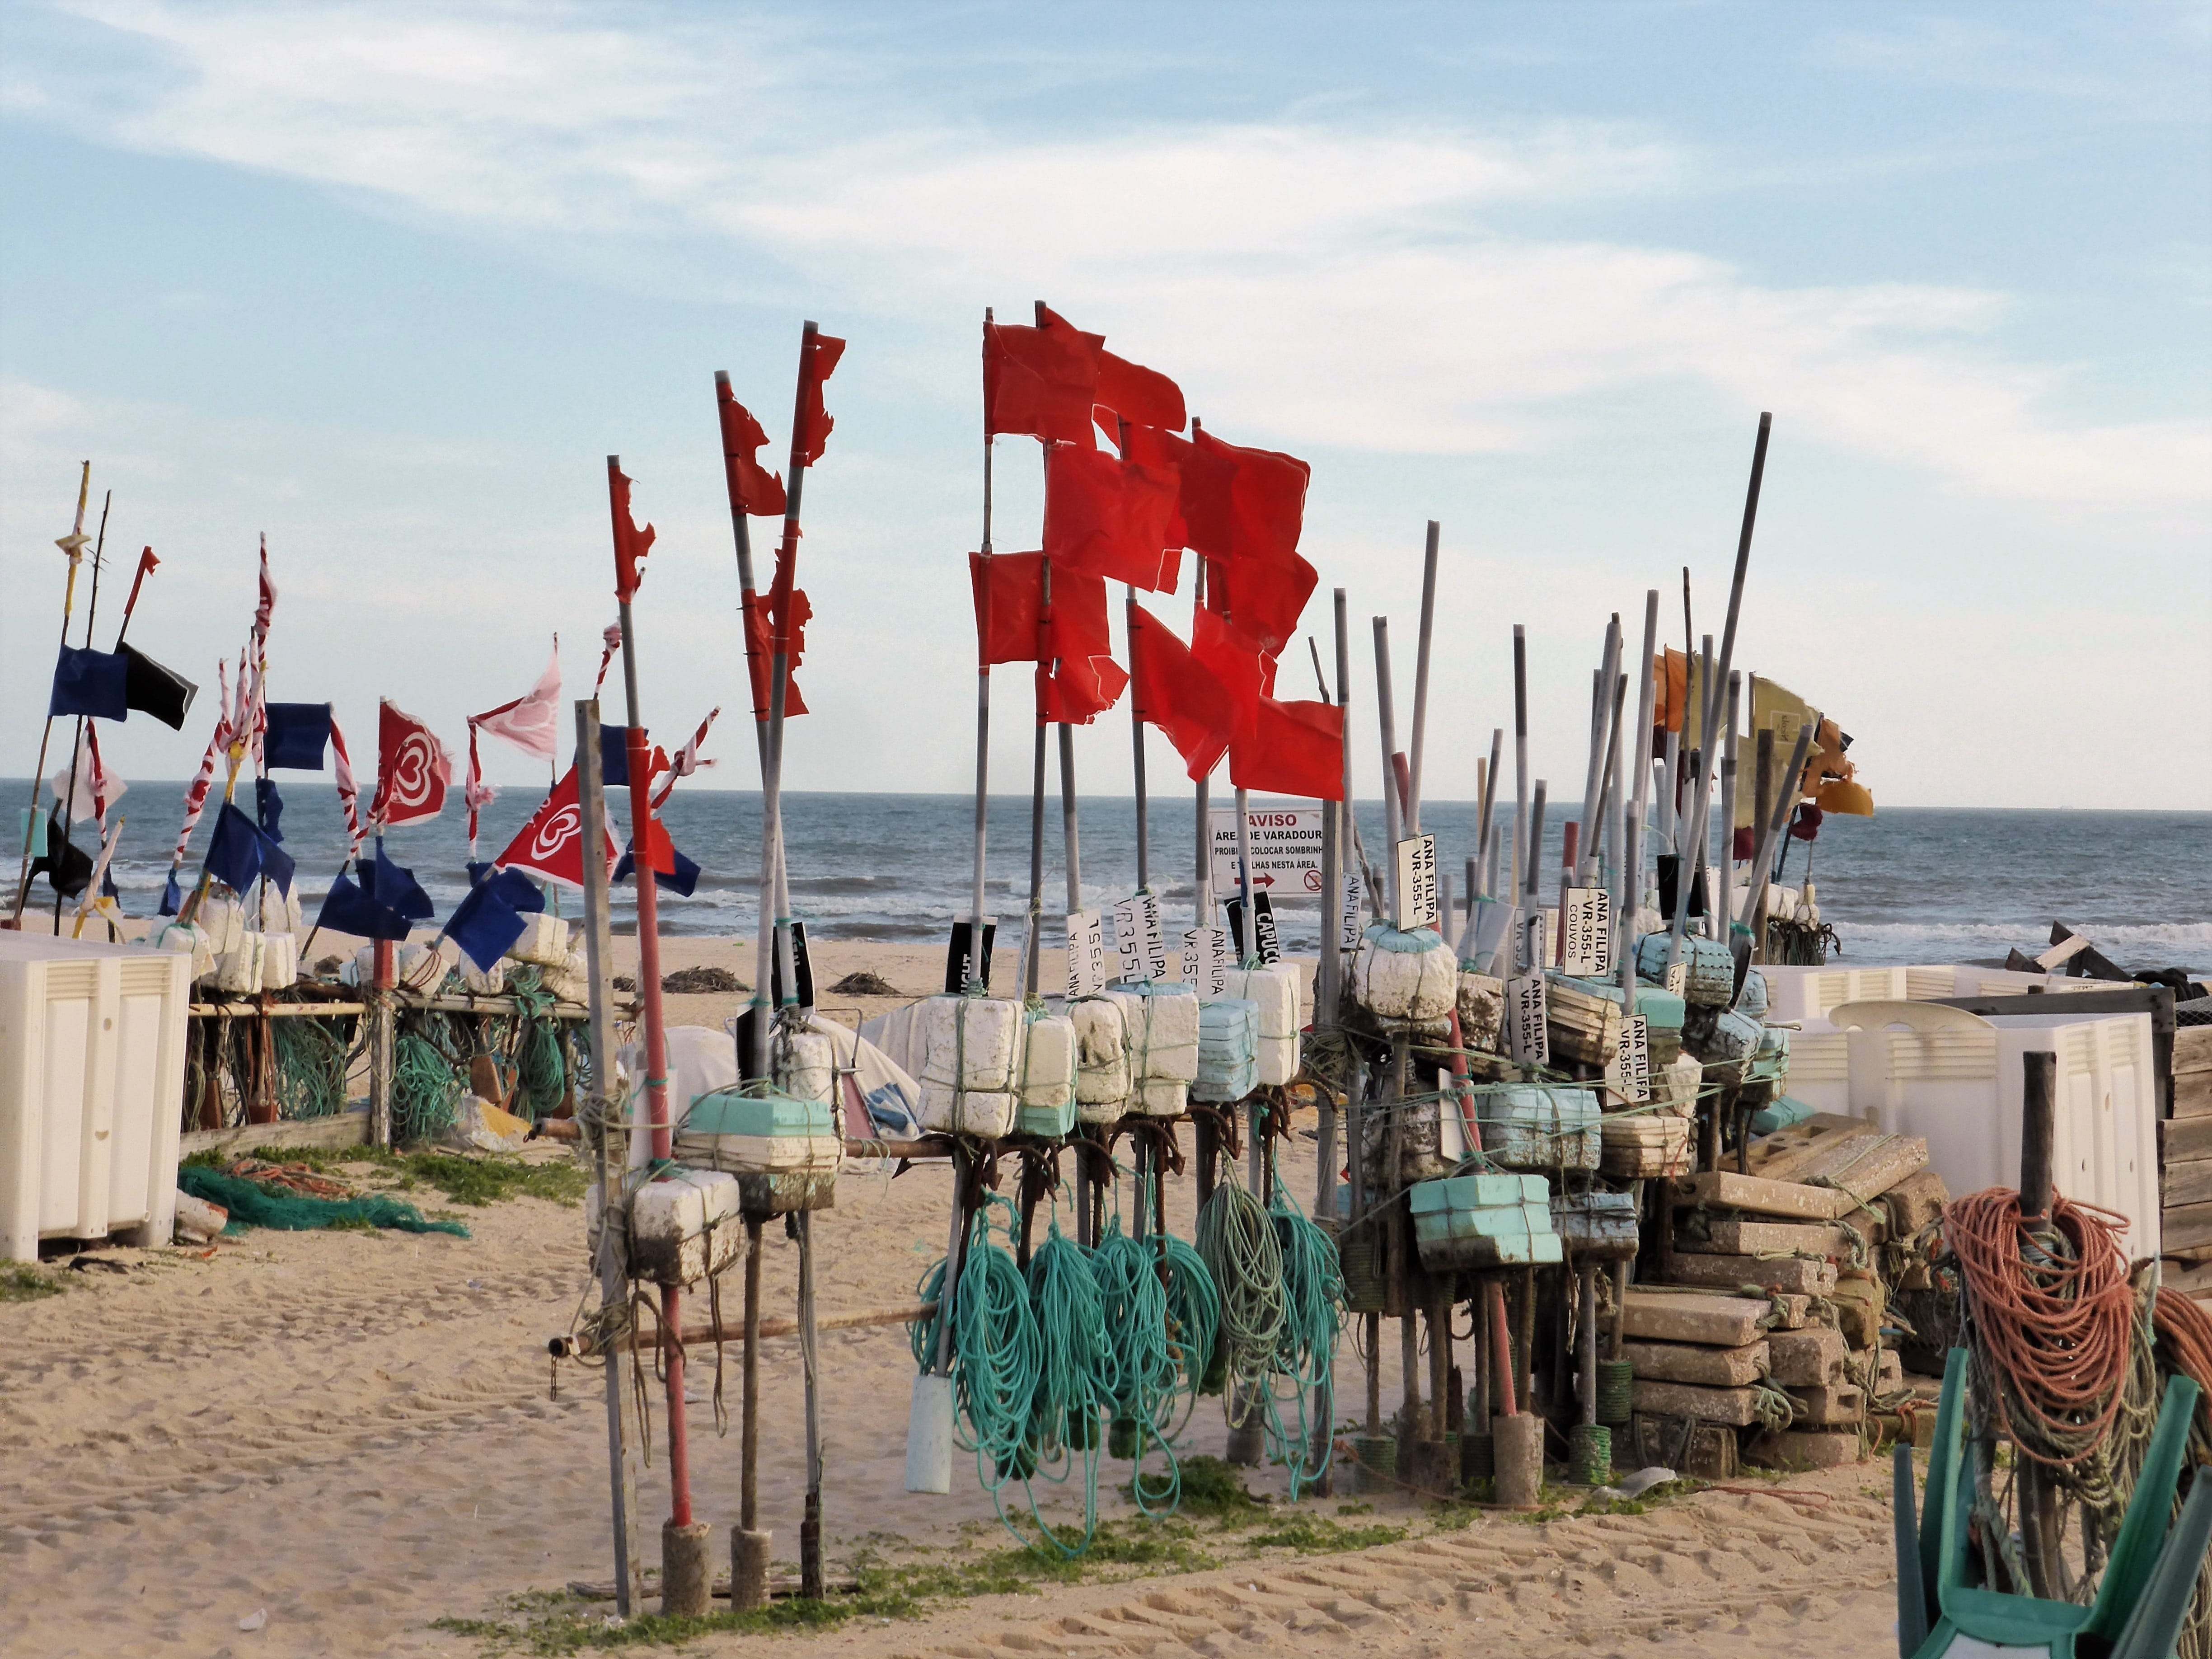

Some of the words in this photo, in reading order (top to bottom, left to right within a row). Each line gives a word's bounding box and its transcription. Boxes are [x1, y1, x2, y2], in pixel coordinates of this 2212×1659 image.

[1216, 830, 1238, 840] ÁRE
[1264, 830, 1322, 839] VARADOUR
[1249, 814, 1297, 826] AVISO
[1215, 847, 1238, 855] PROIBI
[1251, 846, 1284, 855] COLOCAR
[1286, 845, 1322, 854] SOMBRINH
[1272, 861, 1294, 869] NESTA
[1297, 859, 1318, 868] ÁREA.
[1424, 839, 1434, 870] ANA
[1412, 850, 1422, 915] VR-355-L
[1425, 874, 1435, 921] FILIPA
[1597, 892, 1608, 922] ANA
[1568, 904, 1578, 958] COUVOS
[1580, 900, 1593, 963] VR-355-L
[1595, 928, 1607, 972] FILIPA
[1532, 979, 1542, 1010] ANA
[1521, 989, 1532, 1054] VR-355-L
[1533, 1013, 1544, 1060] FILIPA
[1633, 1020, 1645, 1050] ANA
